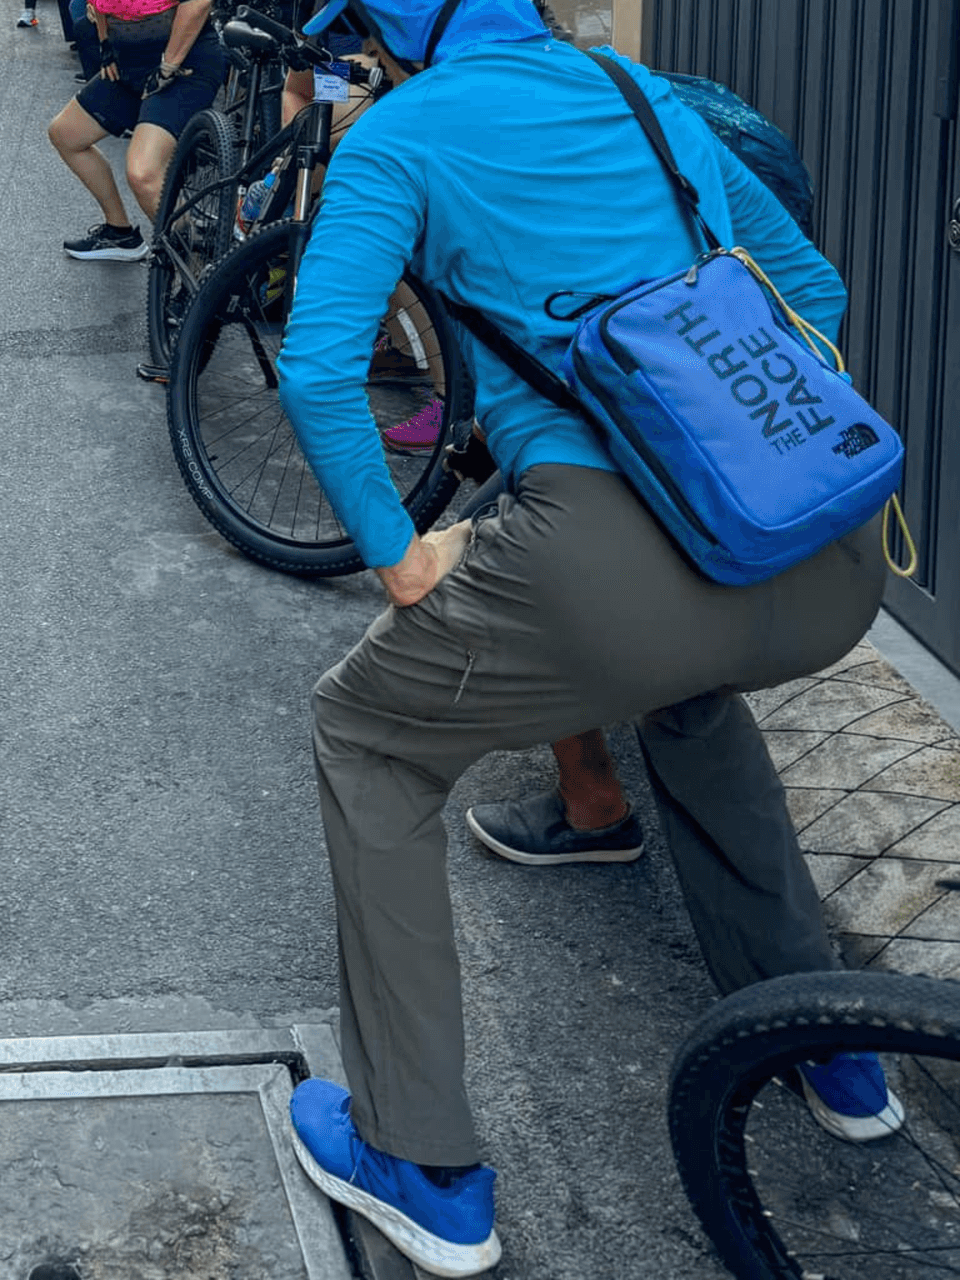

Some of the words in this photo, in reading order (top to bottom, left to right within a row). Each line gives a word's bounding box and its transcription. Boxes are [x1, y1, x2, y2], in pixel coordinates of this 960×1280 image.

[663, 300, 795, 439] NORTH
[737, 326, 836, 437] FACE
[770, 427, 807, 455] THE
[188, 462, 214, 499] COMP
